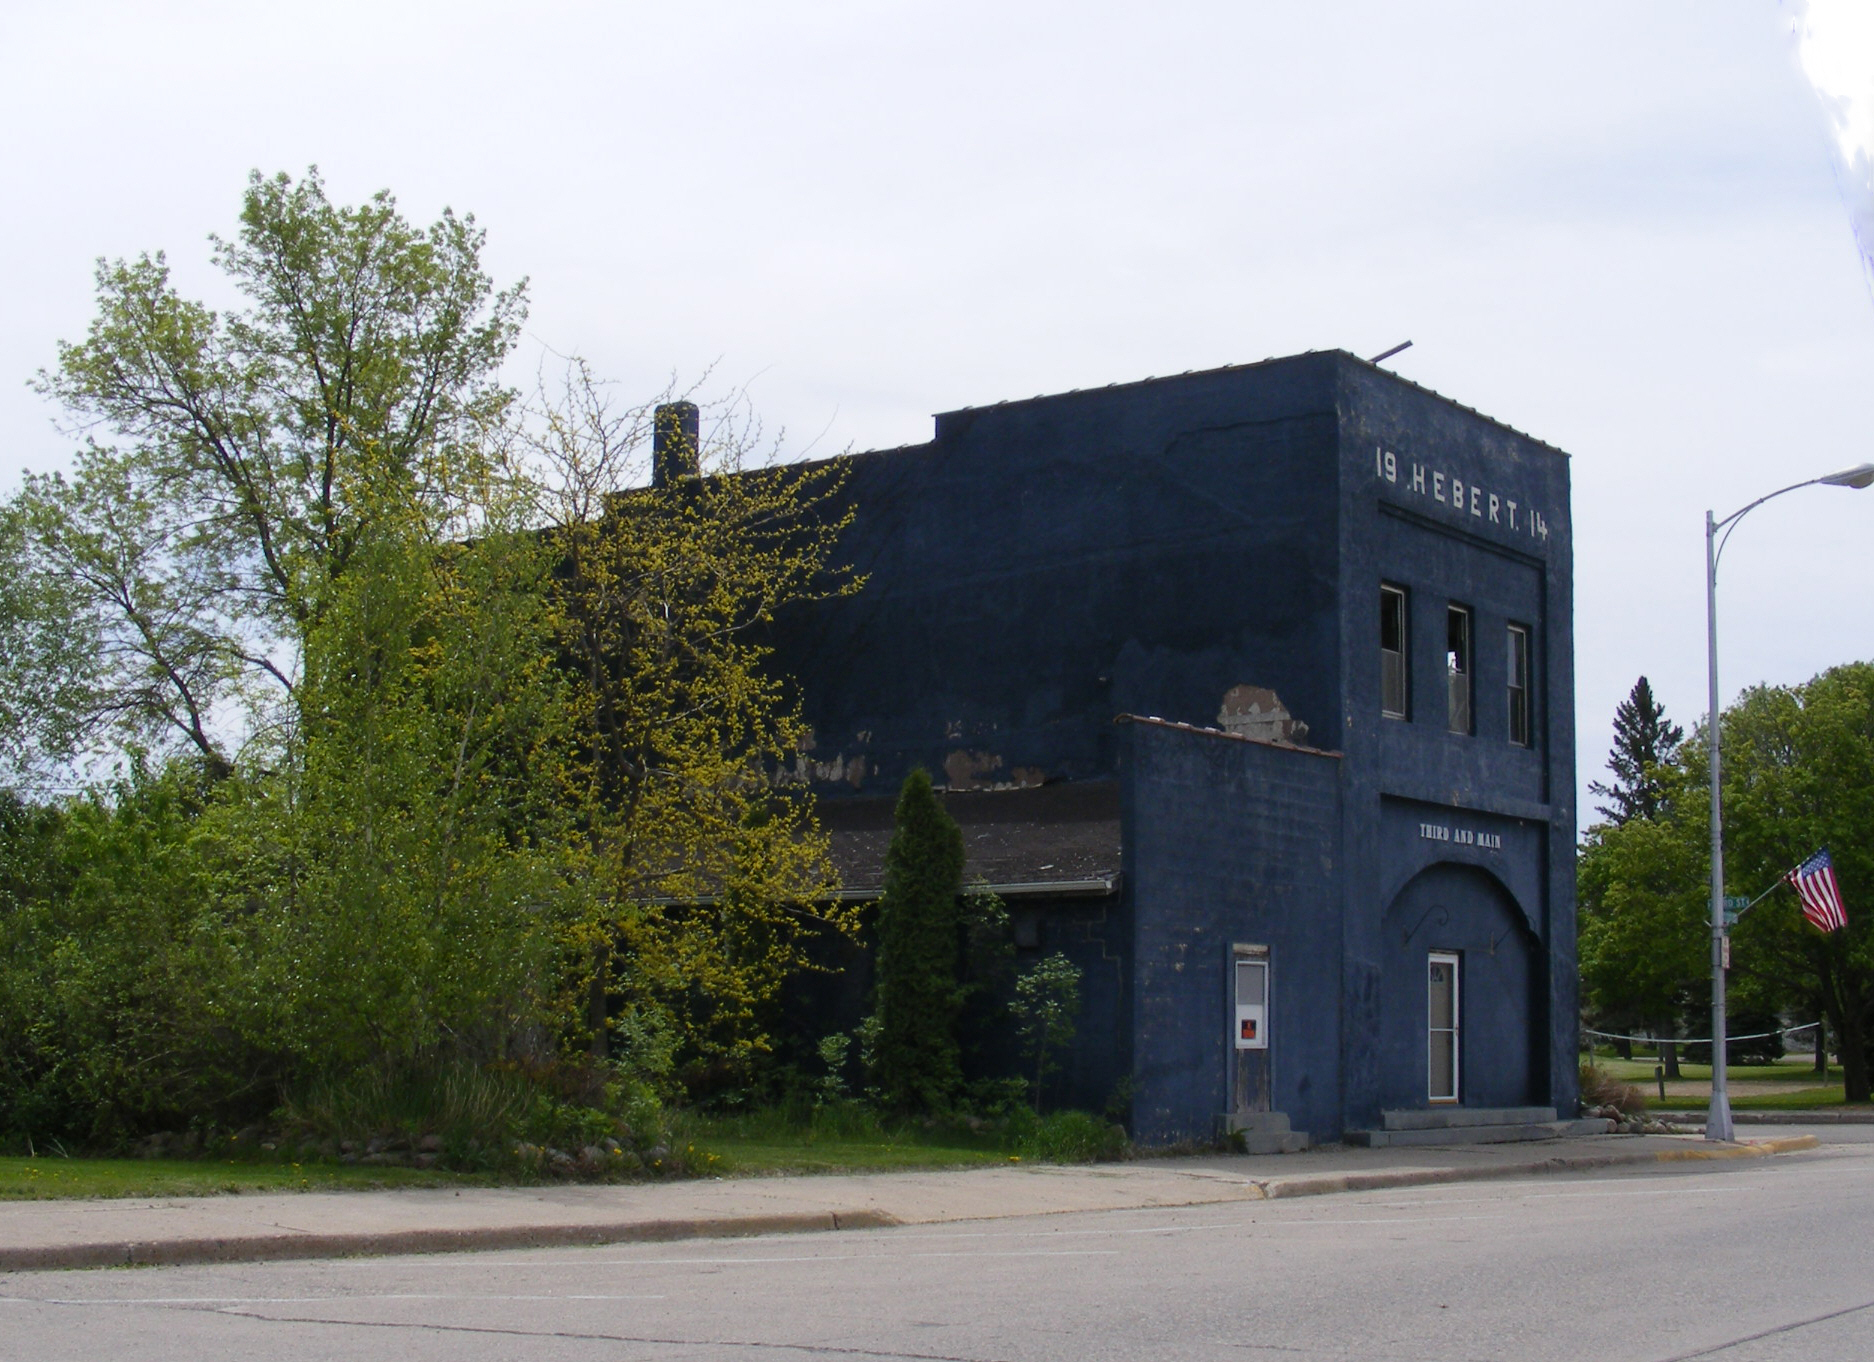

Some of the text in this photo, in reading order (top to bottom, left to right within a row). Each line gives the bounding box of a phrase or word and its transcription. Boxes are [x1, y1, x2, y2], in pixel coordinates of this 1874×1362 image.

[1376, 447, 1397, 483] 19
[1530, 510, 1548, 540] 14
[1420, 823, 1501, 849] THIRD AND MAIN
